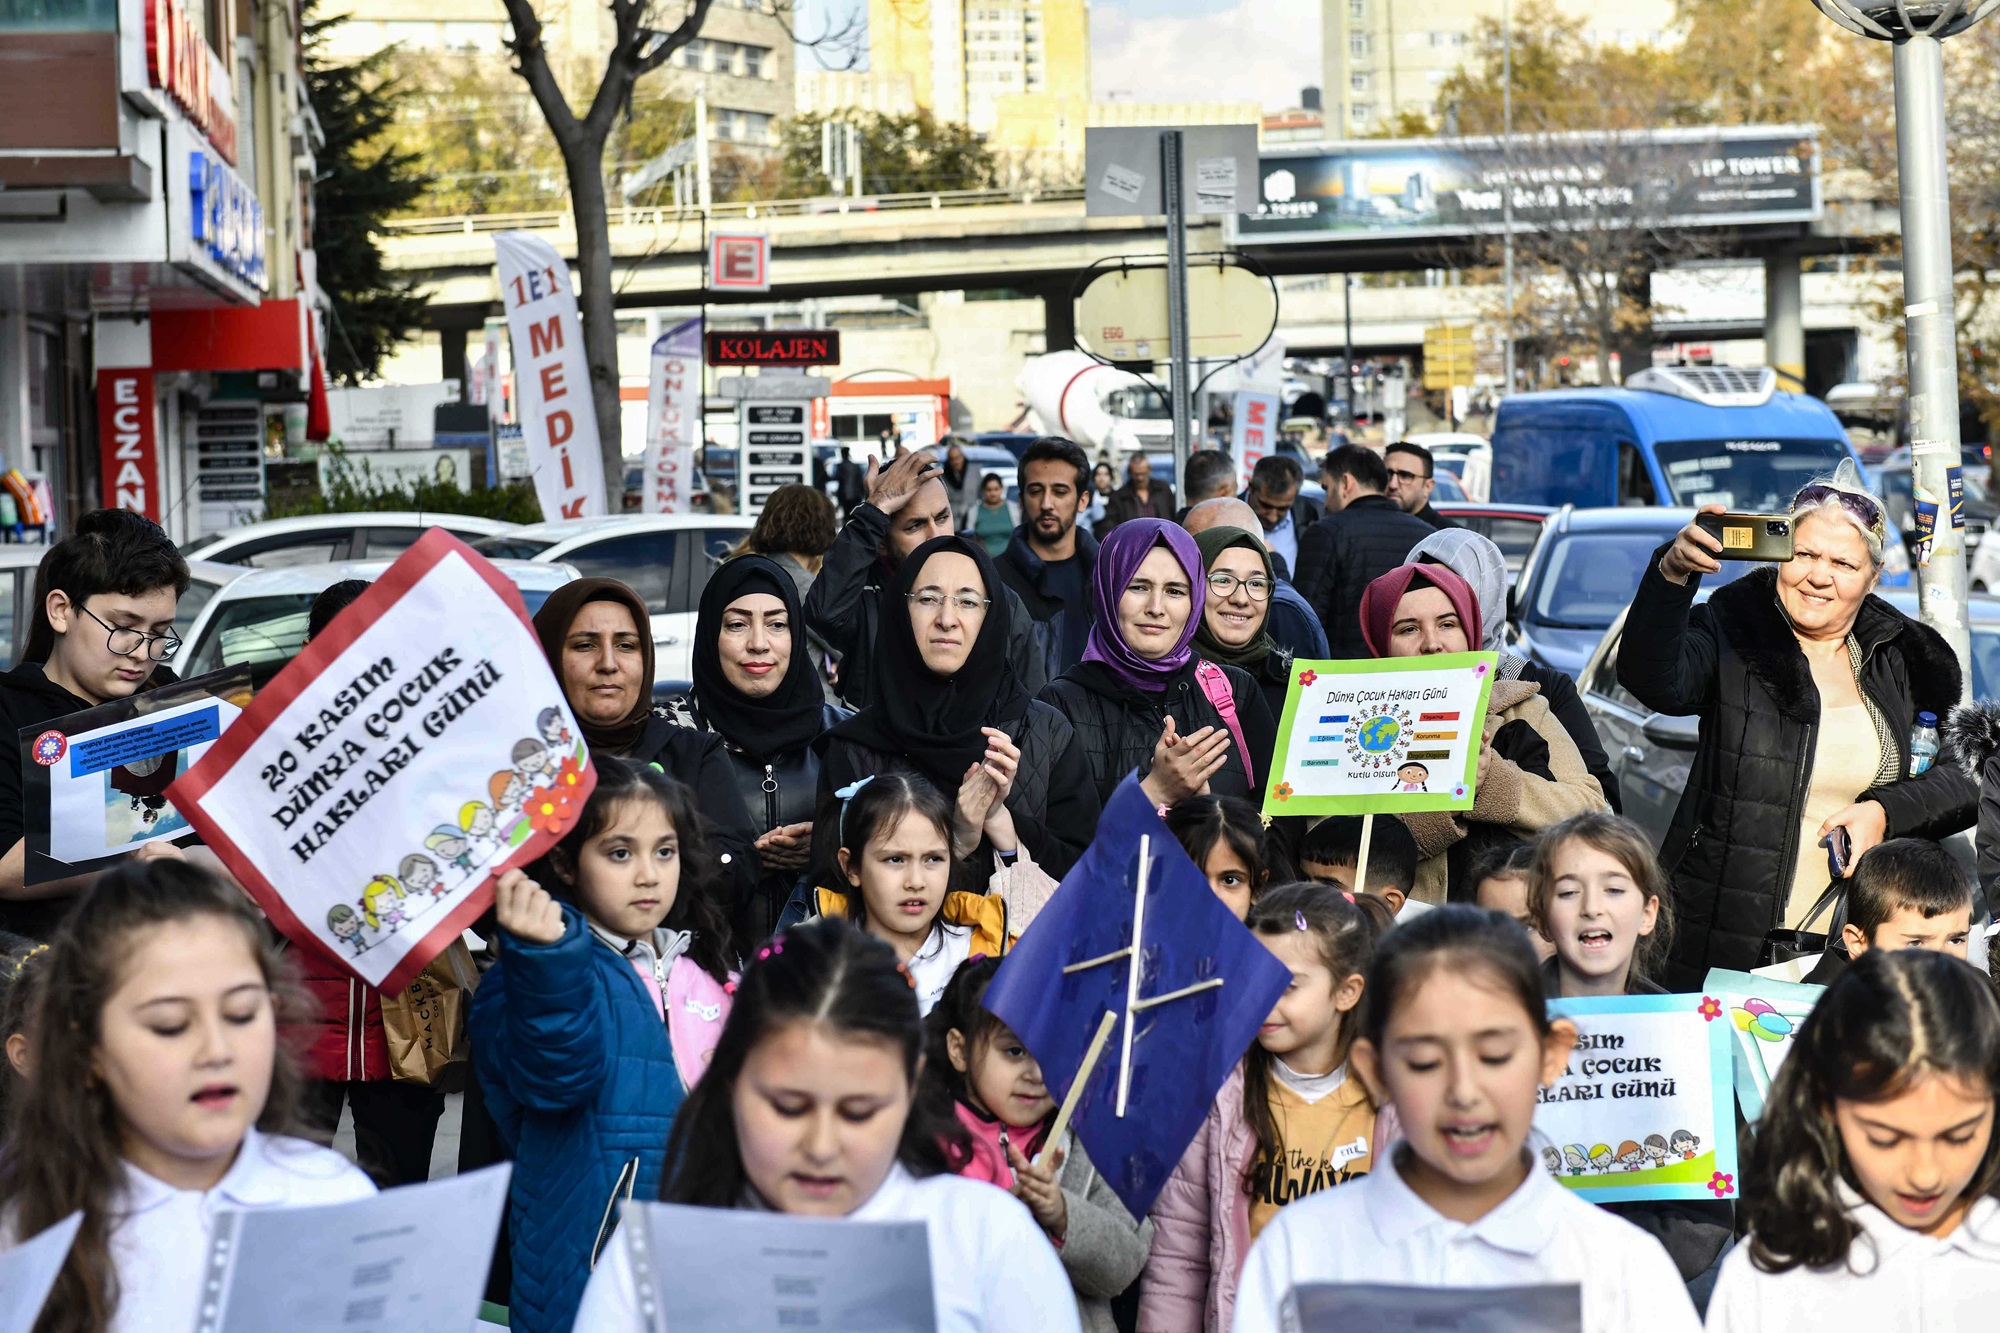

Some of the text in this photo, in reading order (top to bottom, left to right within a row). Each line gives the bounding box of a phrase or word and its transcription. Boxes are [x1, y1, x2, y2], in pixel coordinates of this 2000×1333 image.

[1727, 155, 1801, 176] TOWER
[726, 244, 754, 279] E
[719, 338, 829, 360] KOLAJEN
[113, 378, 146, 513] ECZAN
[1326, 687, 1448, 706] Dünya Çocuk Hakları Günü
[261, 656, 398, 793] 20 KASIM
[270, 647, 464, 831] DÜNYA ÇOCUK
[289, 658, 505, 864] HAKLARI GÜNÜ
[411, 976, 433, 1050] MACKB
[1572, 1033, 1625, 1050] SIM
[1581, 1057, 1662, 1079] ÇOCUK
[1536, 1078, 1677, 1104] LARI GÜNÜ
